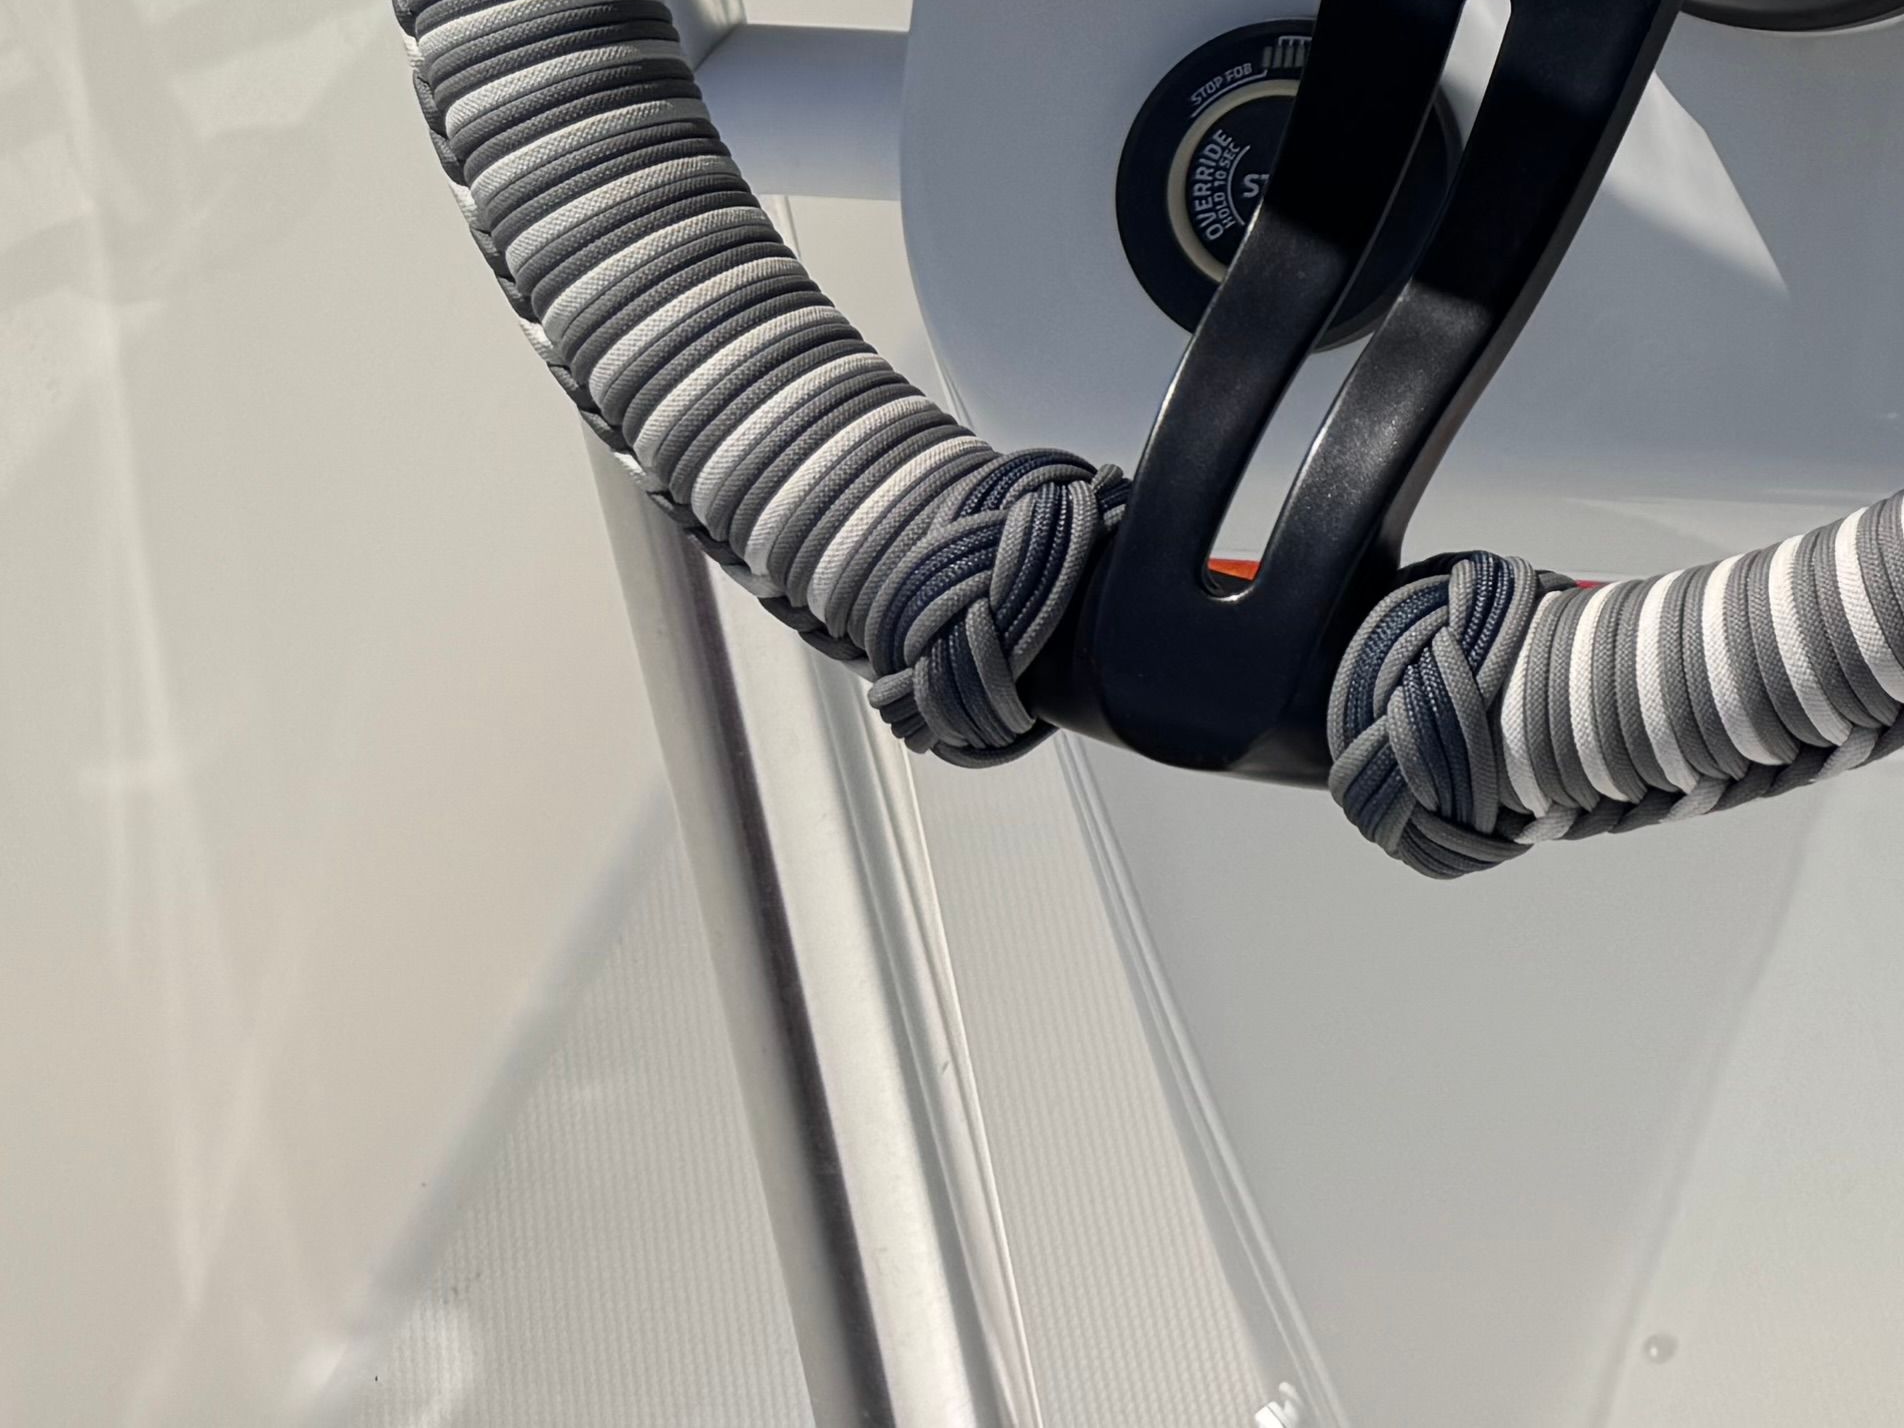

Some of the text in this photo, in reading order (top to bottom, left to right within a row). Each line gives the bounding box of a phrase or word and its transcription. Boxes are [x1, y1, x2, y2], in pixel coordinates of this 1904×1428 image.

[1189, 62, 1253, 107] STOP FOB
[1191, 128, 1233, 241] OVERRIDE
[1212, 141, 1242, 230] HOLD 10 SEC
